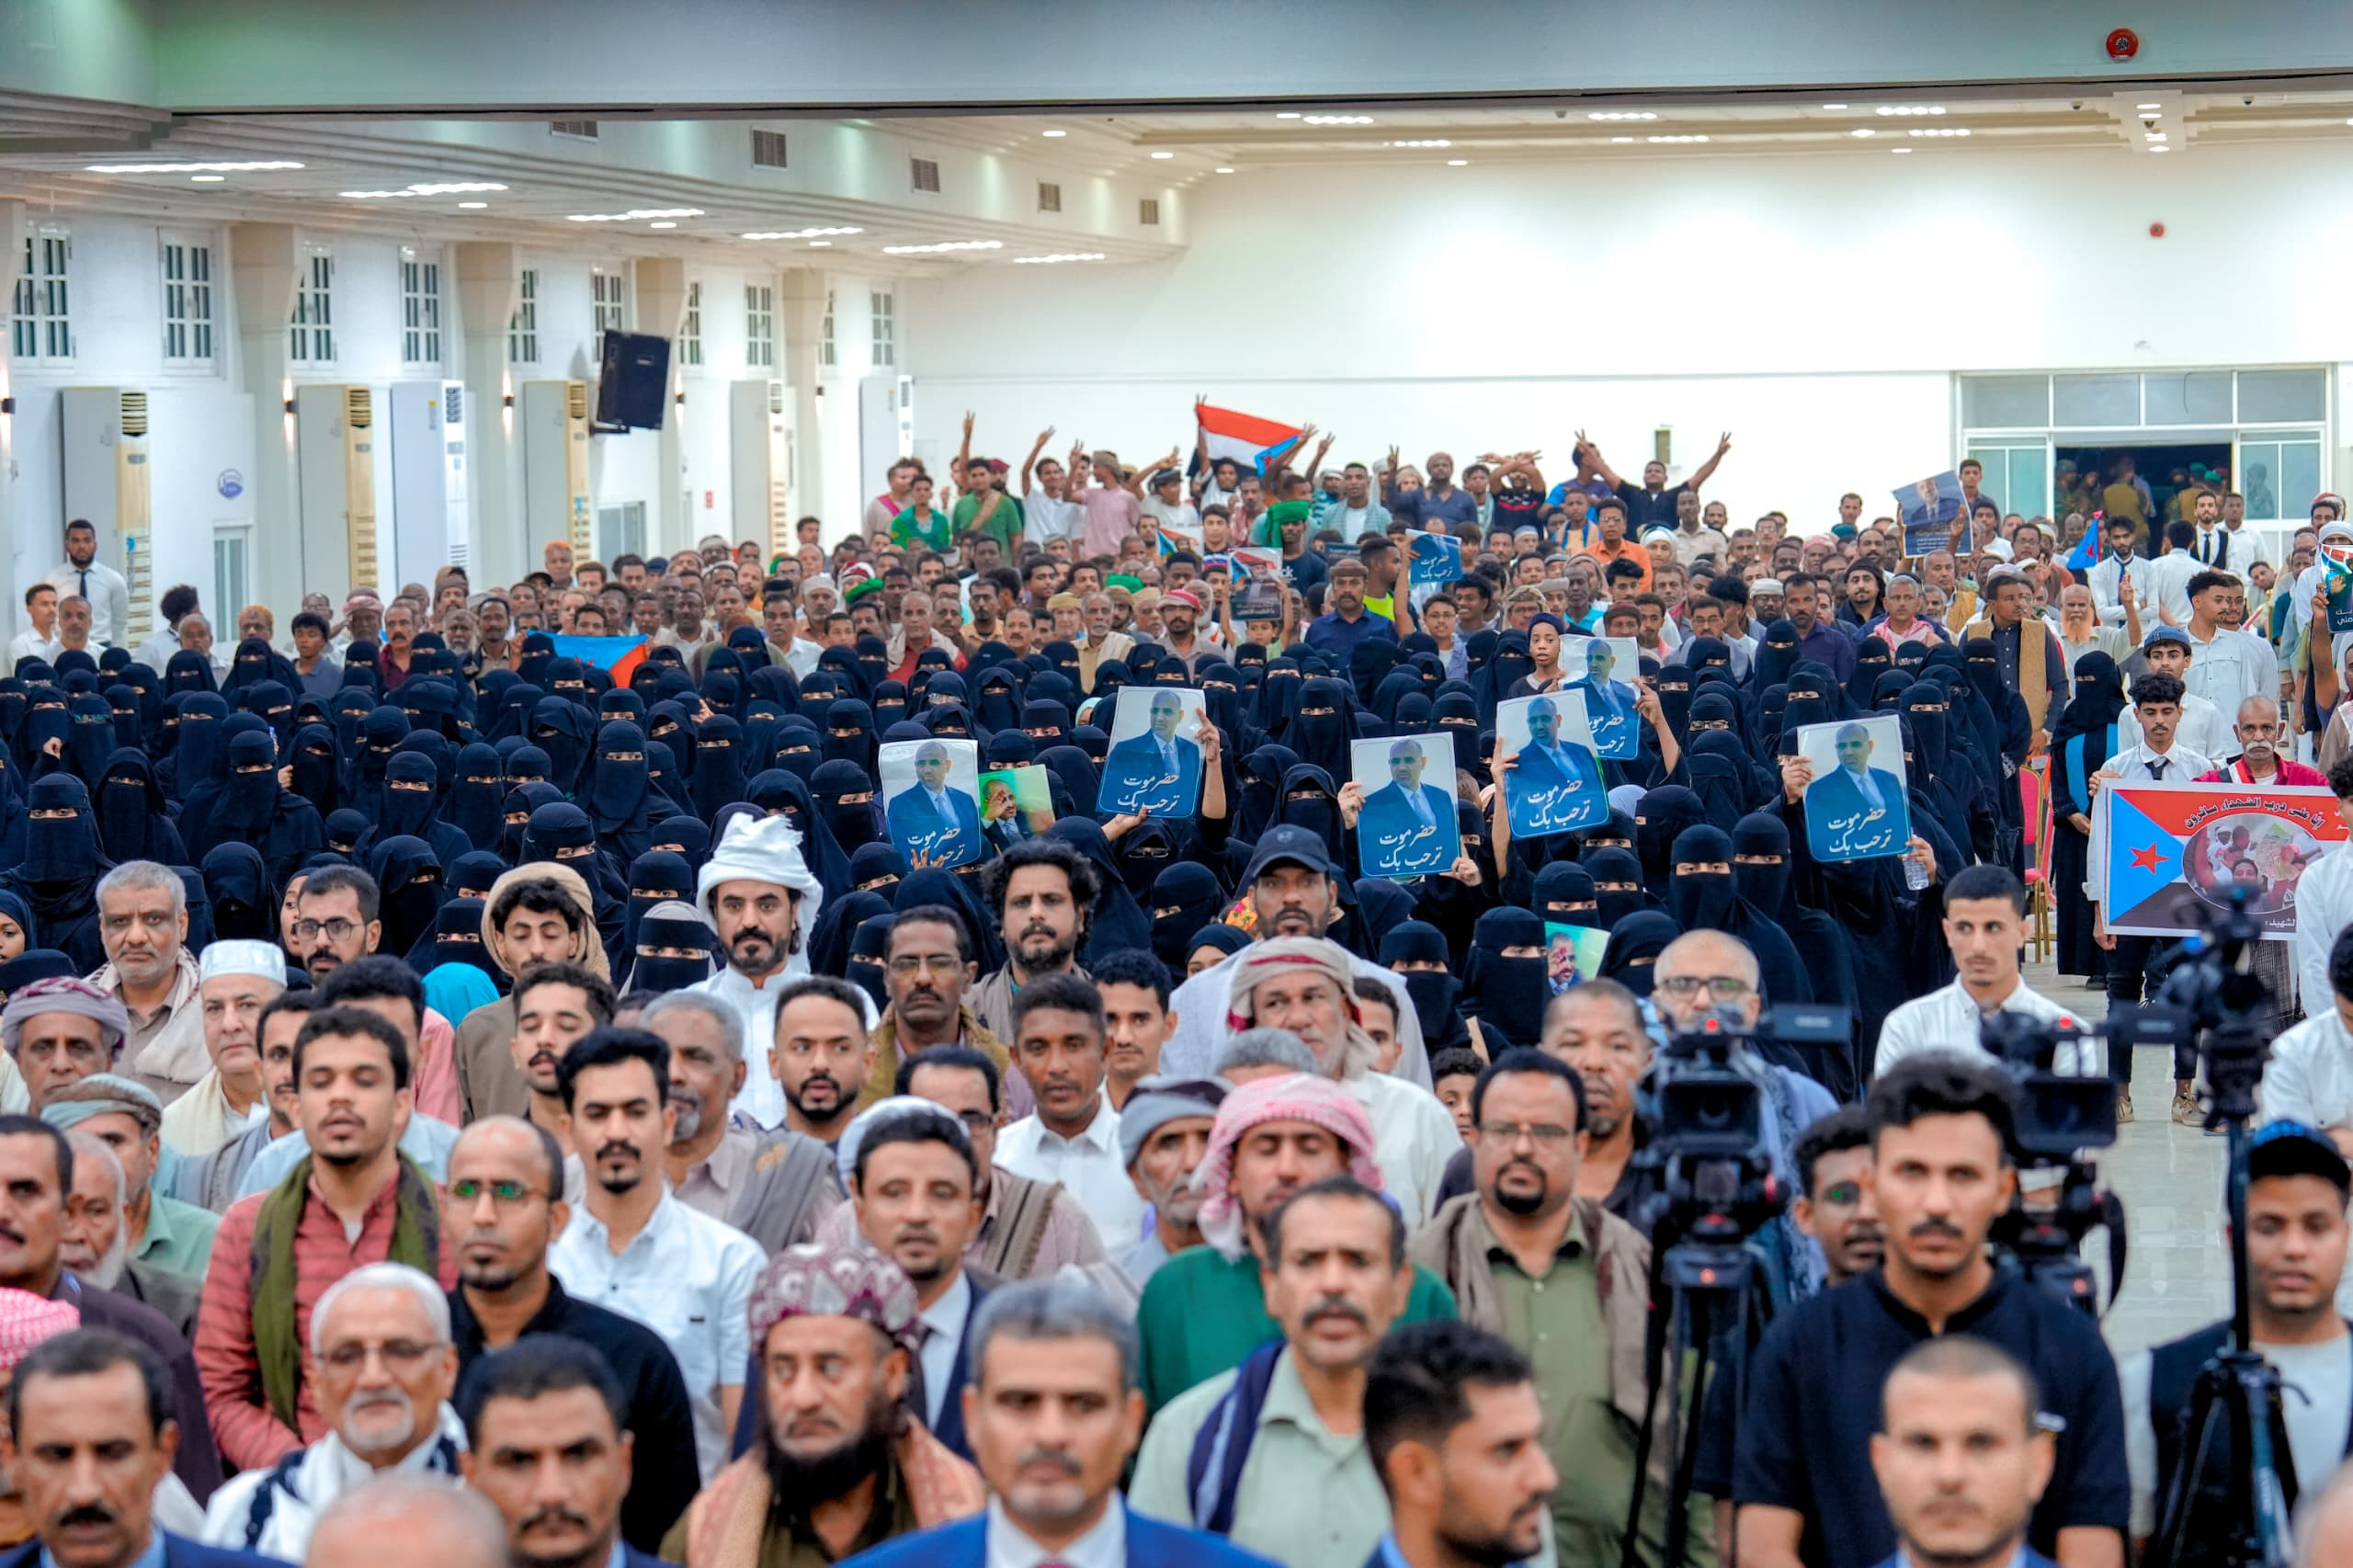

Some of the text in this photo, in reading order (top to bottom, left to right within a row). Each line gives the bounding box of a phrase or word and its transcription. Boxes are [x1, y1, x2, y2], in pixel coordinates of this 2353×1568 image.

[1588, 713, 1624, 733] حضرمو
[1123, 772, 1180, 792] حضرموت
[1528, 779, 1583, 804] حضرموت
[1117, 788, 1180, 813] ترحب بك
[2221, 797, 2261, 811] الشهداء
[2264, 801, 2287, 812] درب
[1529, 799, 1591, 830] ترحب بك
[1828, 808, 1886, 831] حضرموت
[907, 826, 961, 849] حضرموت
[1380, 824, 1438, 847] حضرموت
[1829, 827, 1893, 856] ترحب بك
[930, 844, 966, 864] ترح
[1380, 844, 1442, 871] ترحب بك
